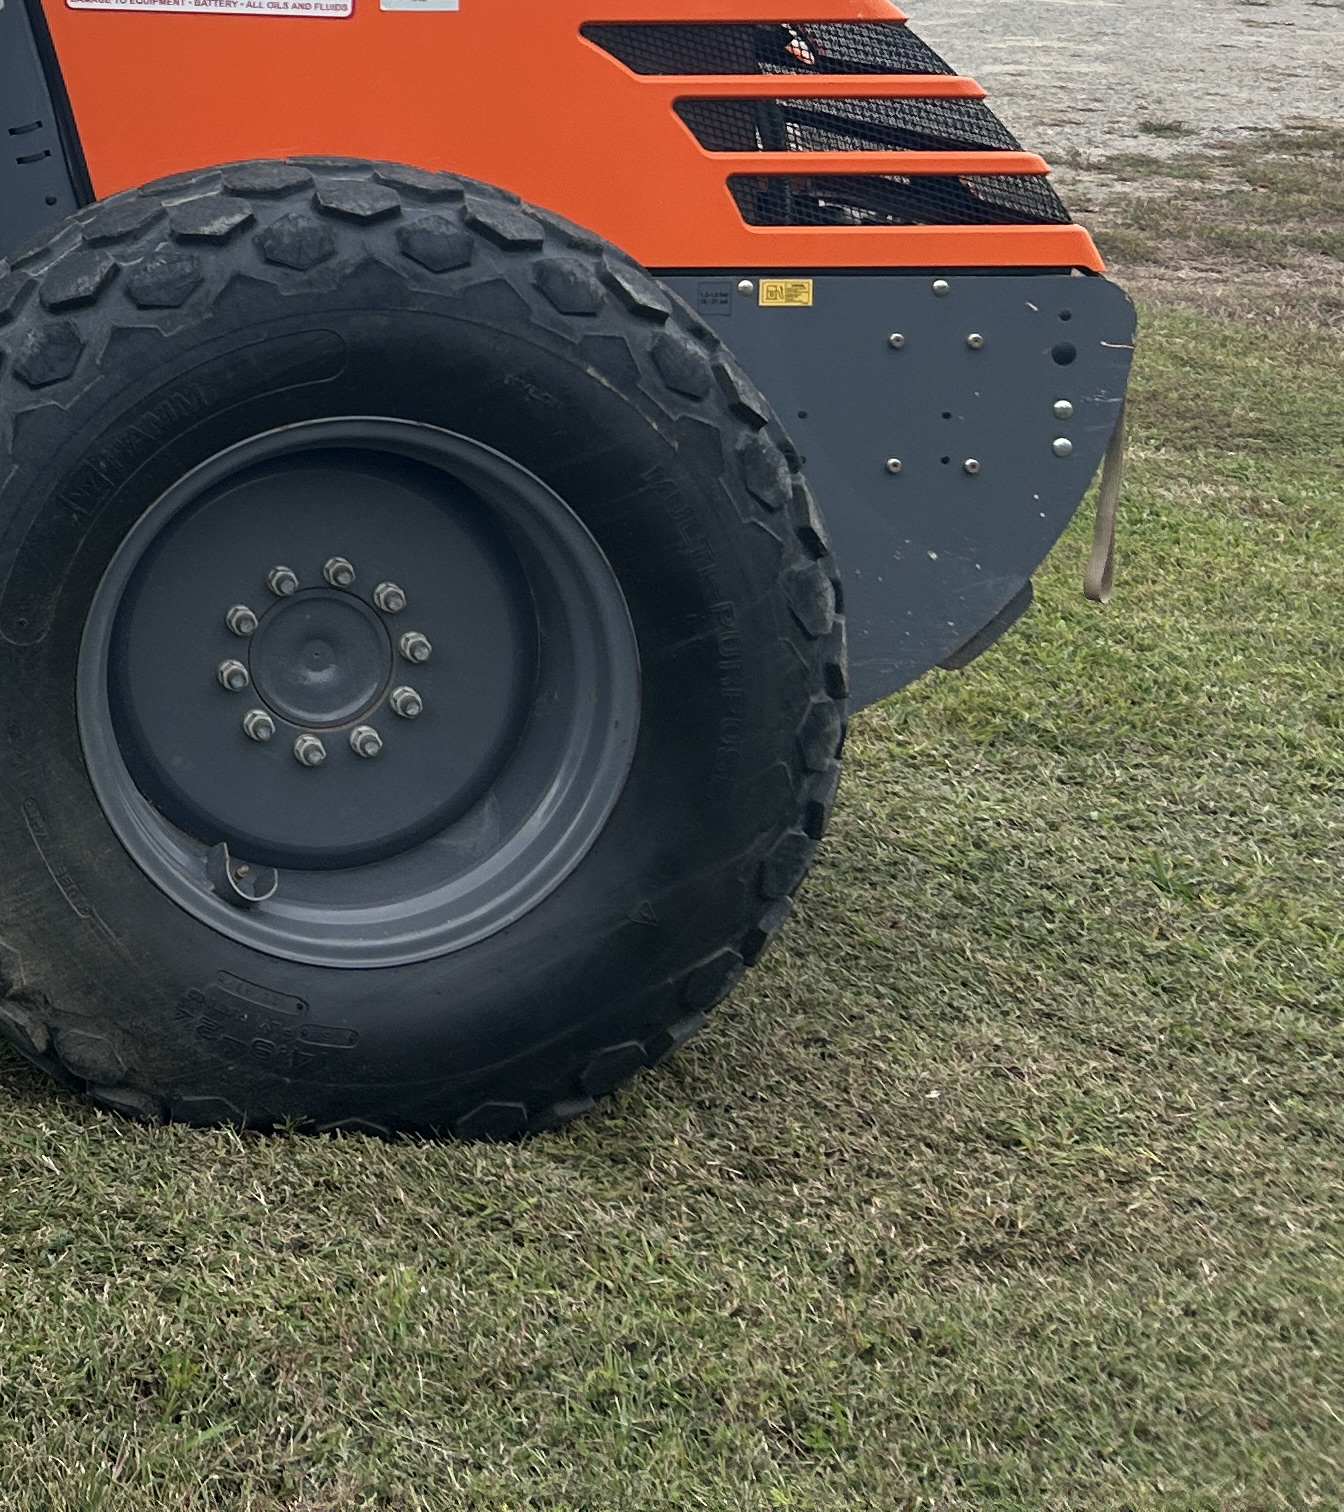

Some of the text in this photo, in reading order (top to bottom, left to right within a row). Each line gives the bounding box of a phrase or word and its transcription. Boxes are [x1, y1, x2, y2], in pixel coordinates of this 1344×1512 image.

[246, 0, 265, 9] ALL
[266, 1, 289, 9] OILS
[291, 2, 312, 11] AND
[314, 3, 349, 12] FLUIDS
